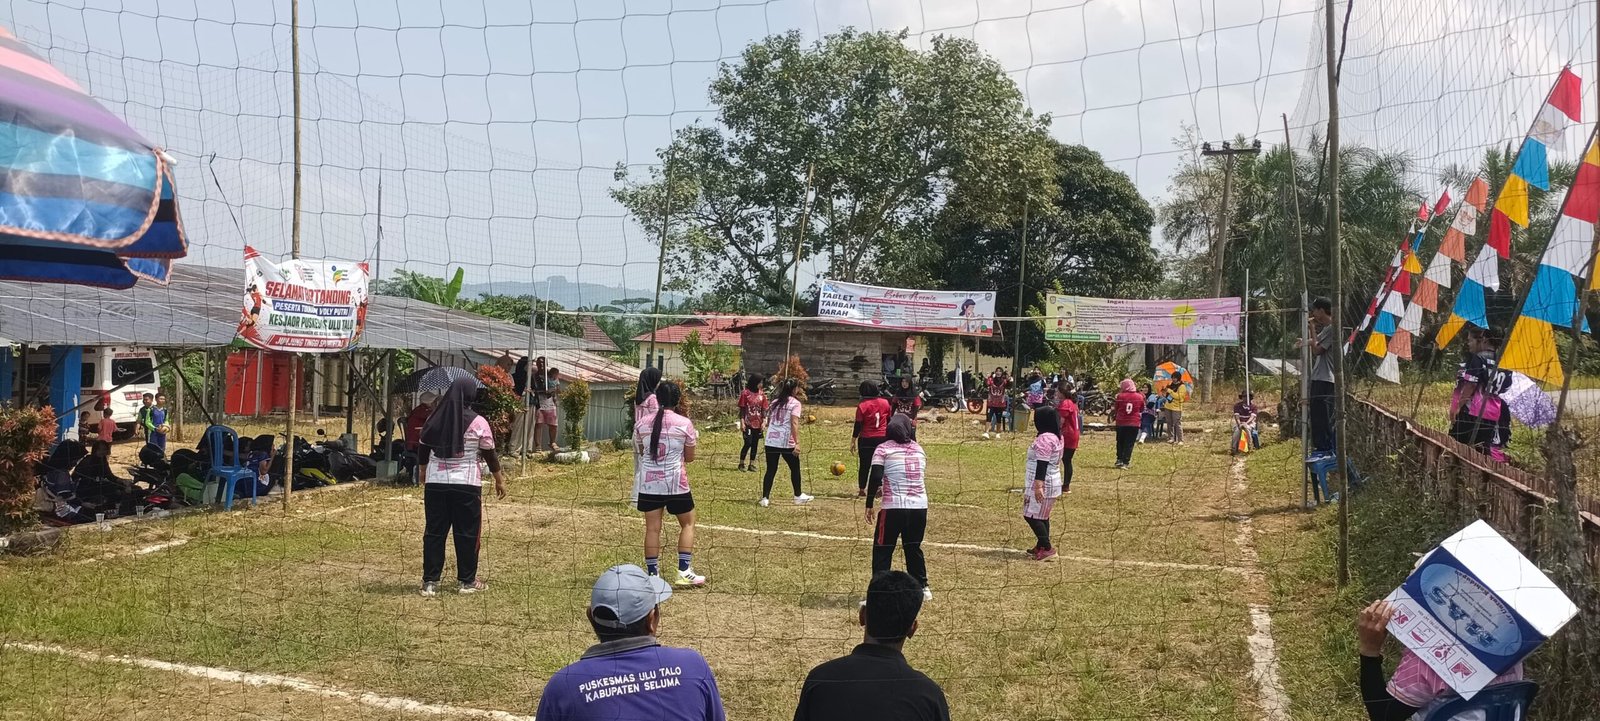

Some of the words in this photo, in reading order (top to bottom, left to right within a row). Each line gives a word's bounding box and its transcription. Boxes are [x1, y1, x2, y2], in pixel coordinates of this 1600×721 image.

[822, 292, 854, 301] TABLET
[819, 308, 849, 316] DARAH
[821, 300, 856, 310] TAMBAH
[1126, 402, 1133, 414] 9
[874, 412, 881, 429] 1
[1430, 586, 1498, 648] MAS
[579, 674, 636, 693] PUSKESMAS
[639, 670, 656, 680] ULU
[659, 666, 682, 678] TALO
[585, 683, 640, 703] KABUPATEN
[644, 677, 681, 691] SELUMA
